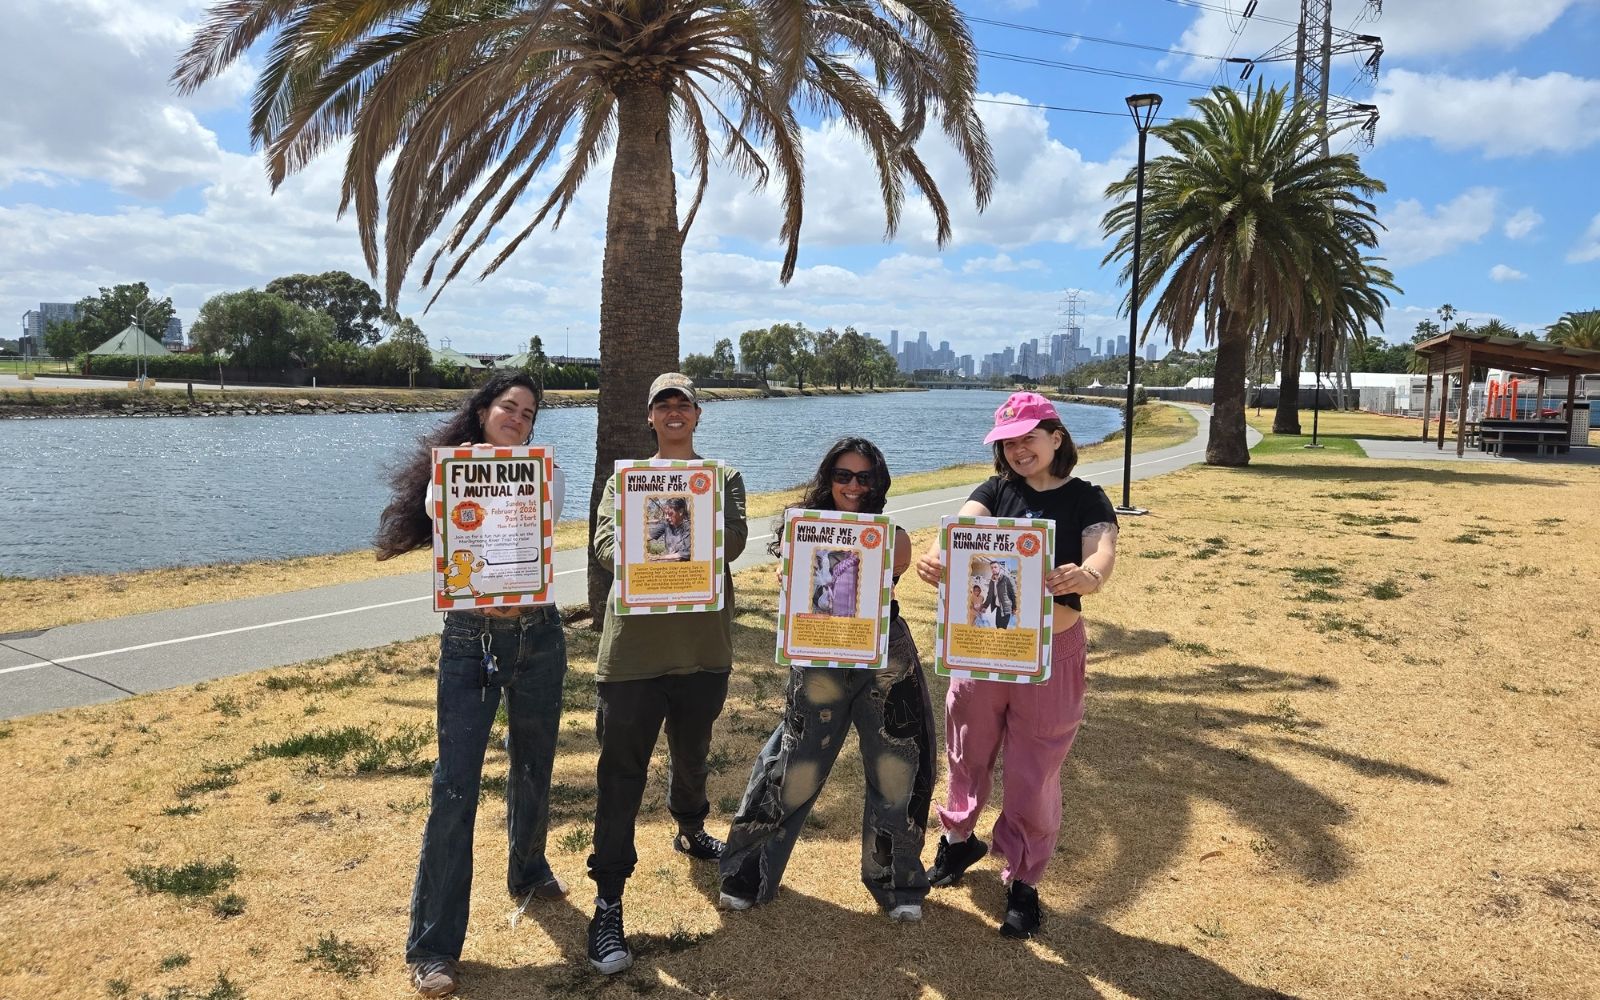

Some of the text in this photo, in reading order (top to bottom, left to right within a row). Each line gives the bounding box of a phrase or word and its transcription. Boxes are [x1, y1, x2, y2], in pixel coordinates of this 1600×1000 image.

[452, 463, 534, 484] FUN RUN
[628, 475, 682, 483] WHO ARE WE
[452, 484, 535, 498] 4 MUTUAL AID
[628, 483, 688, 492] RUNNING FOR?
[797, 525, 852, 537] WHO ARE WE
[797, 534, 857, 545] RUNNING FOR?
[953, 532, 1010, 543] WHO ARE WE
[953, 541, 1015, 552] RUNNING FOR?
